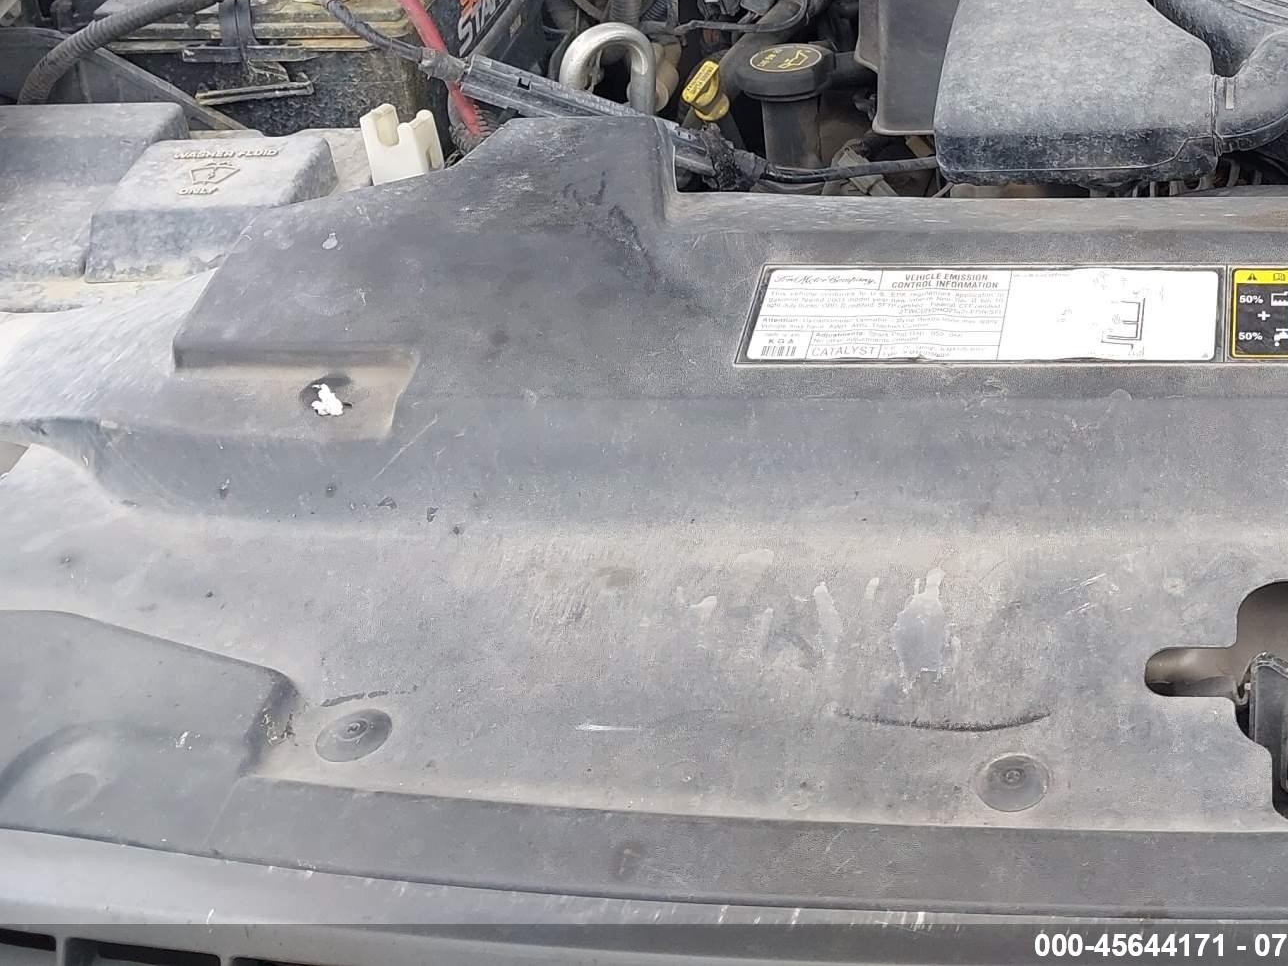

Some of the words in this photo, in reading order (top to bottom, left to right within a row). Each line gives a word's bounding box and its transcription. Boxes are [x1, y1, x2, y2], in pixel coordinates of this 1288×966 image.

[174, 150, 235, 159] WASHER
[237, 148, 279, 158] FLUID
[178, 186, 219, 195] ONLY
[905, 273, 942, 281] VEHICLE
[944, 273, 989, 281] EMISSION
[891, 281, 932, 289] CONTROL
[936, 281, 999, 289] INFORMATION
[1239, 295, 1264, 304] 50%
[1238, 332, 1263, 341] 50%
[811, 345, 877, 356] CATALYST
